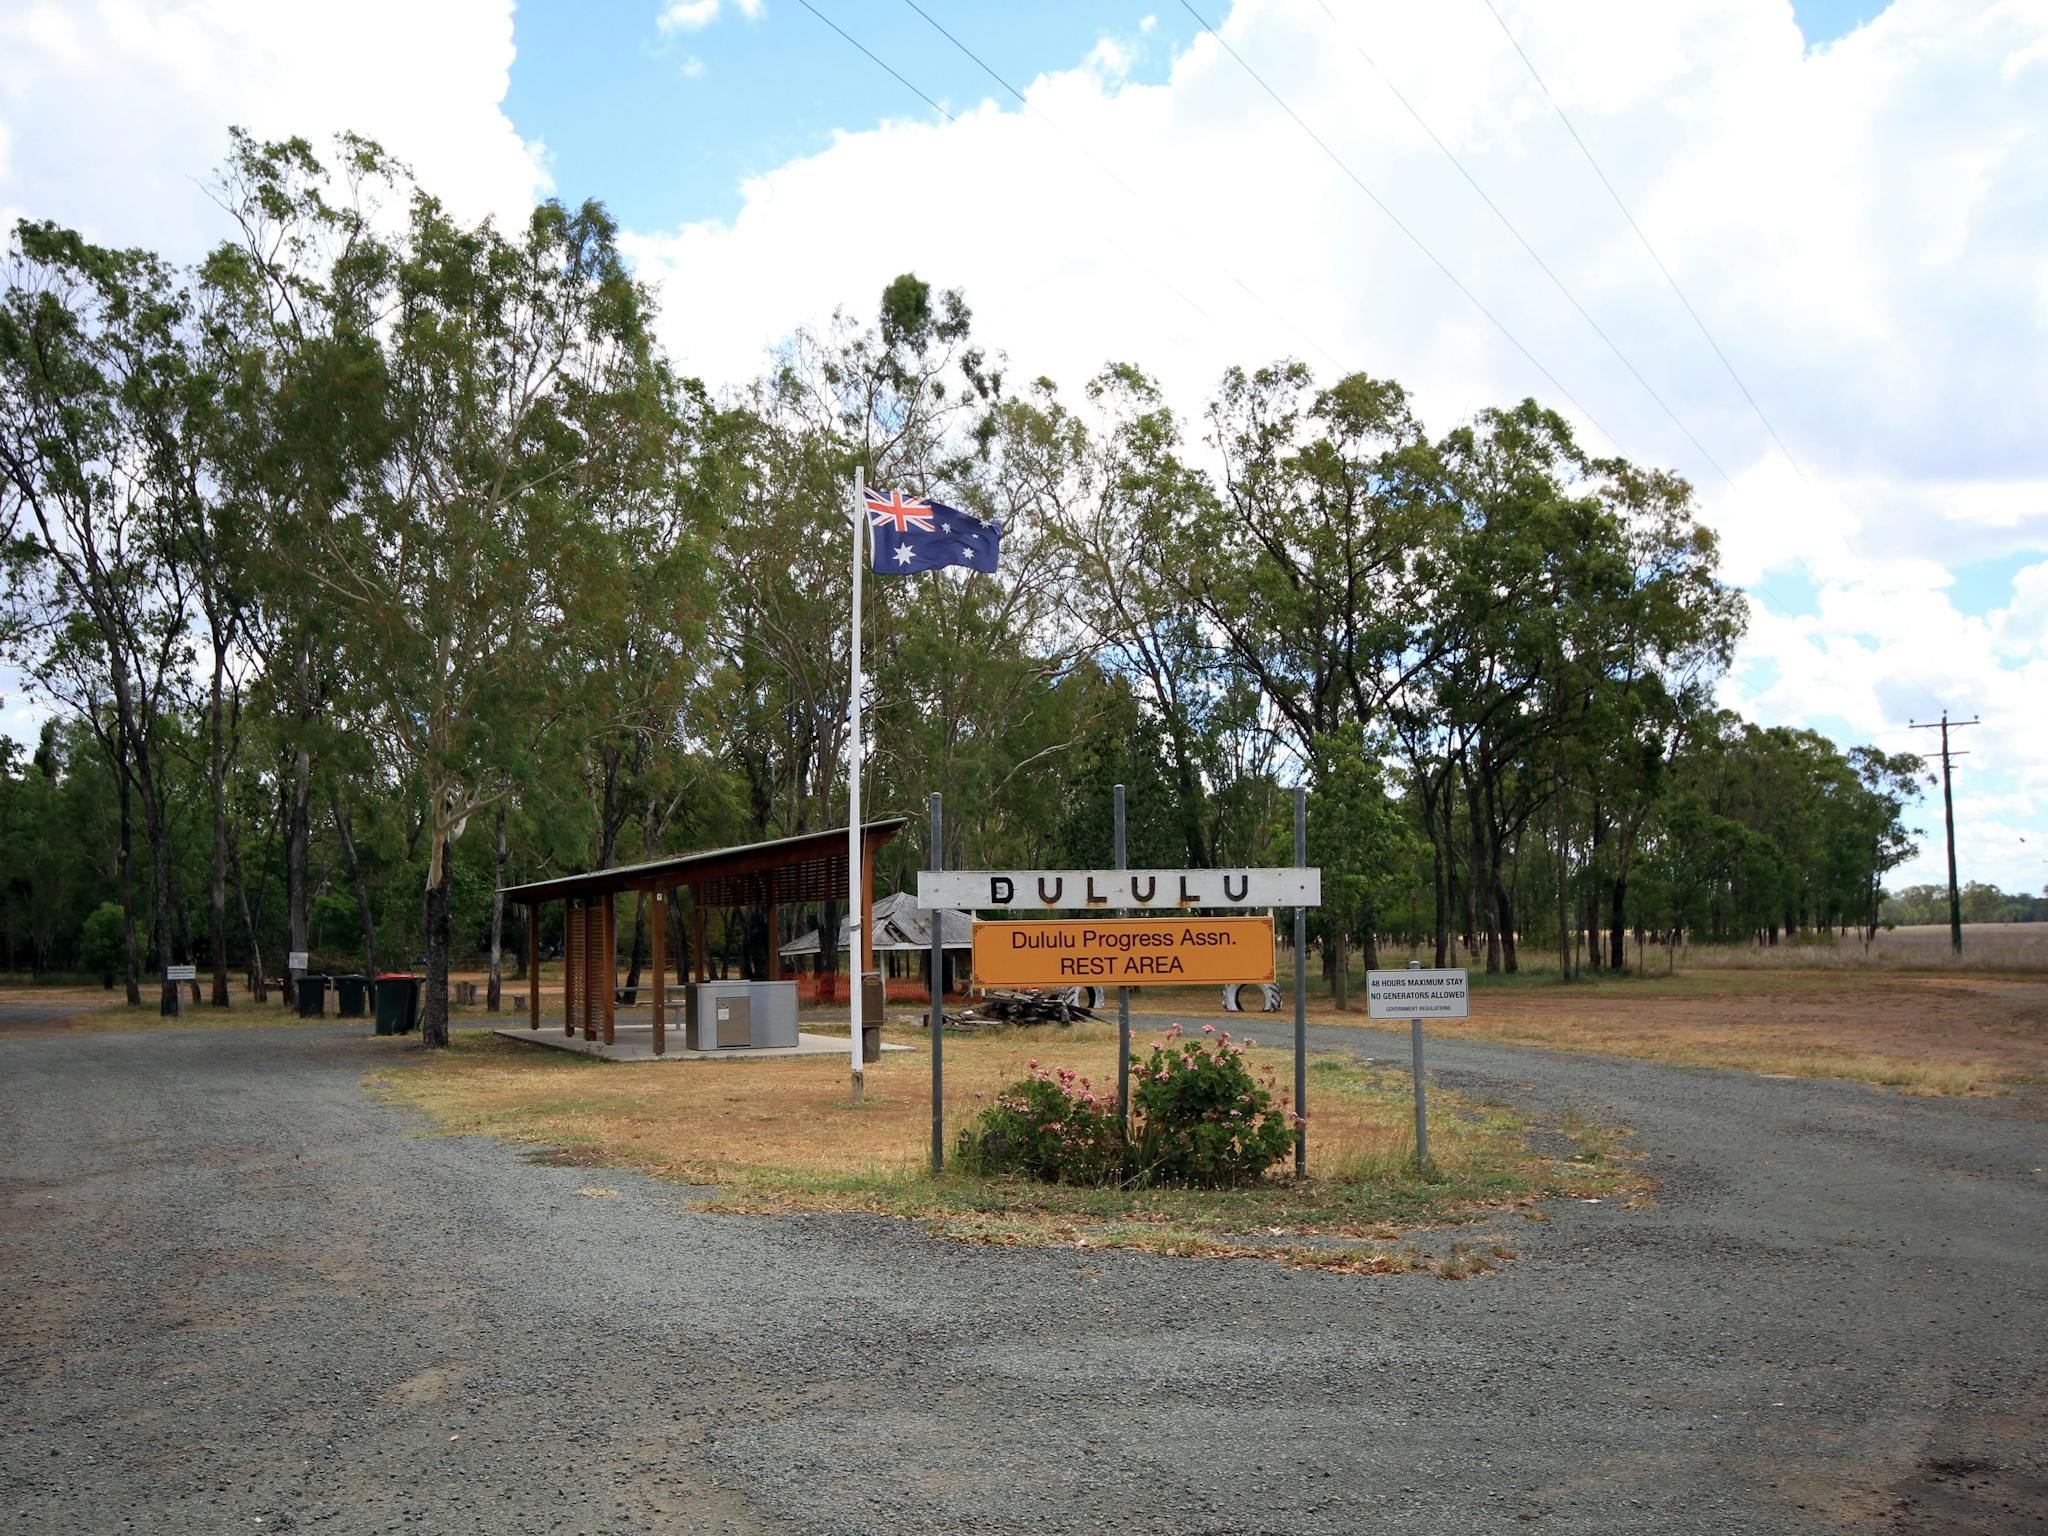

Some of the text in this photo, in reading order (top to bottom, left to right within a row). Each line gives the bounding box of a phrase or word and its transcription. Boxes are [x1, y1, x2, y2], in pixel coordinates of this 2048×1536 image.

[991, 875, 1248, 904] DULULU
[1012, 928, 1237, 951] Dululu Progress Assn.
[1061, 956, 1184, 975] REST AREA
[1382, 979, 1406, 987] HOURS
[1408, 978, 1444, 987] MAXIMUM
[1446, 978, 1463, 986] STAY
[1371, 991, 1465, 1000] NO GENERATORS ALLOWED
